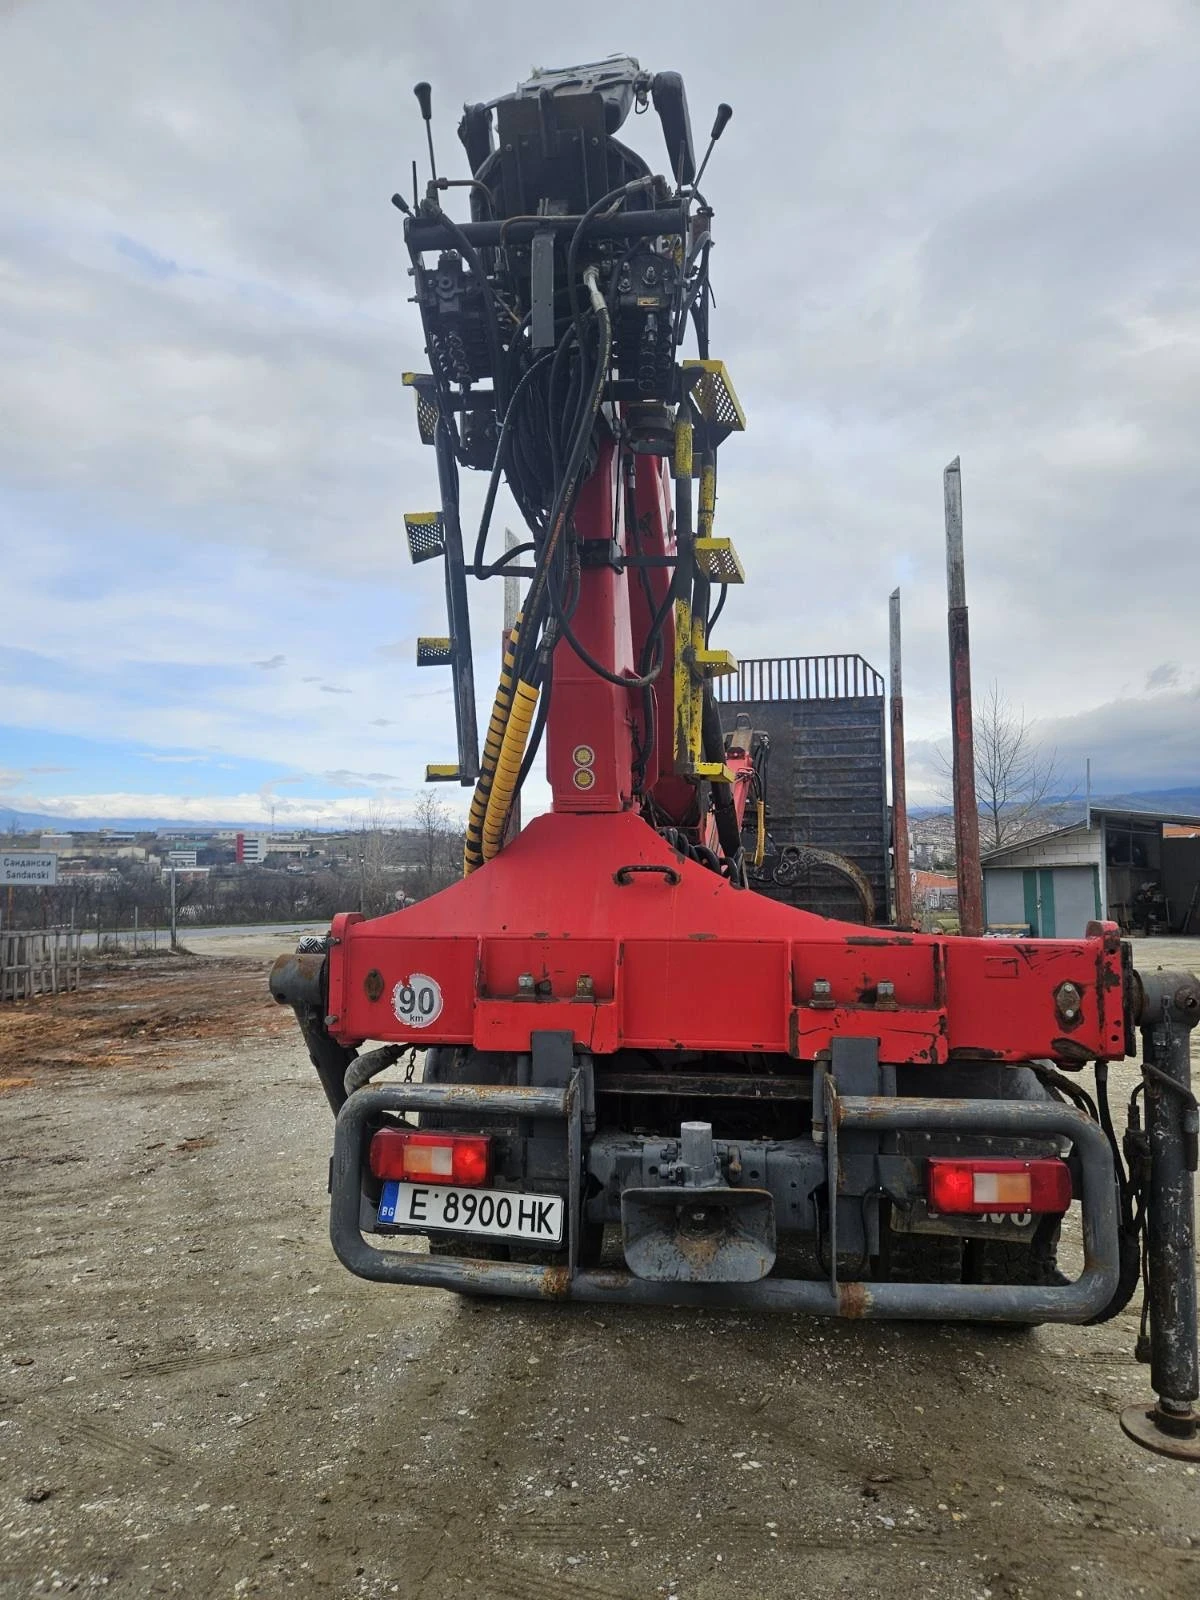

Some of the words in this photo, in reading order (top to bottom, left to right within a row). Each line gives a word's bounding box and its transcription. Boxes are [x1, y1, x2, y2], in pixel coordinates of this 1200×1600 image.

[3, 857, 52, 868] Сандански
[6, 870, 49, 879] Sandanski
[399, 986, 435, 1015] 90
[409, 1014, 424, 1022] km
[381, 1206, 395, 1217] BG
[409, 1188, 429, 1221] E
[443, 1192, 512, 1229] 8900
[518, 1199, 556, 1235] HK
